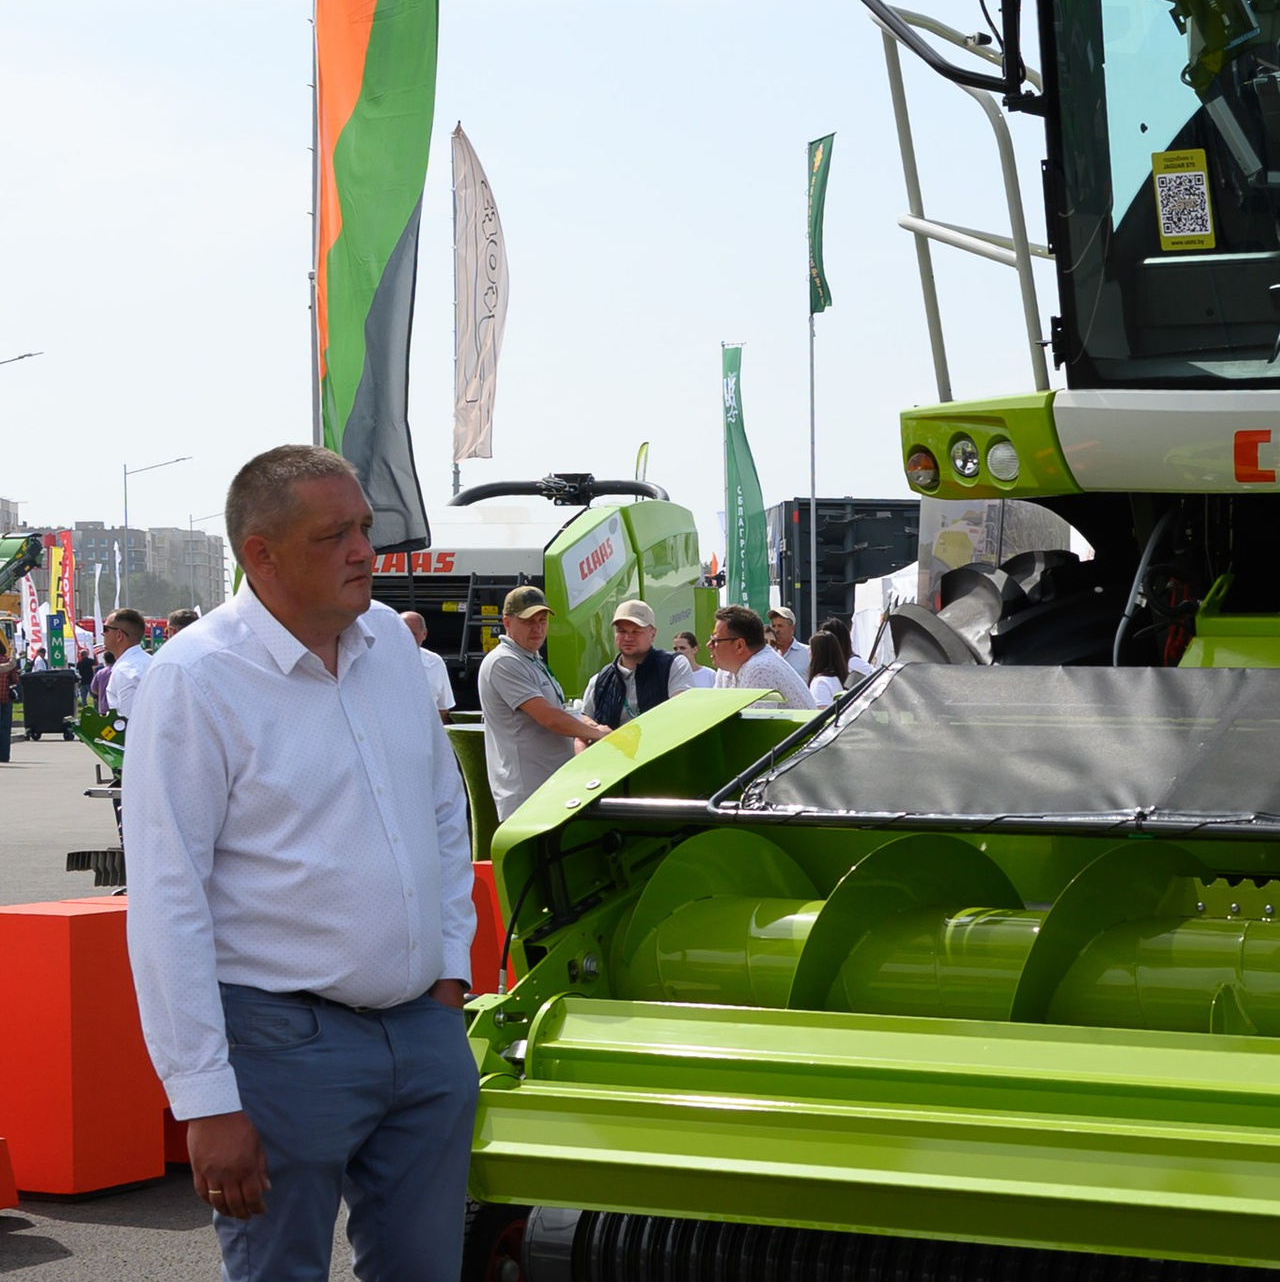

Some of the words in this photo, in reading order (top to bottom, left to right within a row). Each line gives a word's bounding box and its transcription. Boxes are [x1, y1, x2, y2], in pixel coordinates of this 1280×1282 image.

[579, 536, 614, 581] CLAAS
[53, 618, 60, 626] P
[54, 650, 61, 659] 6
